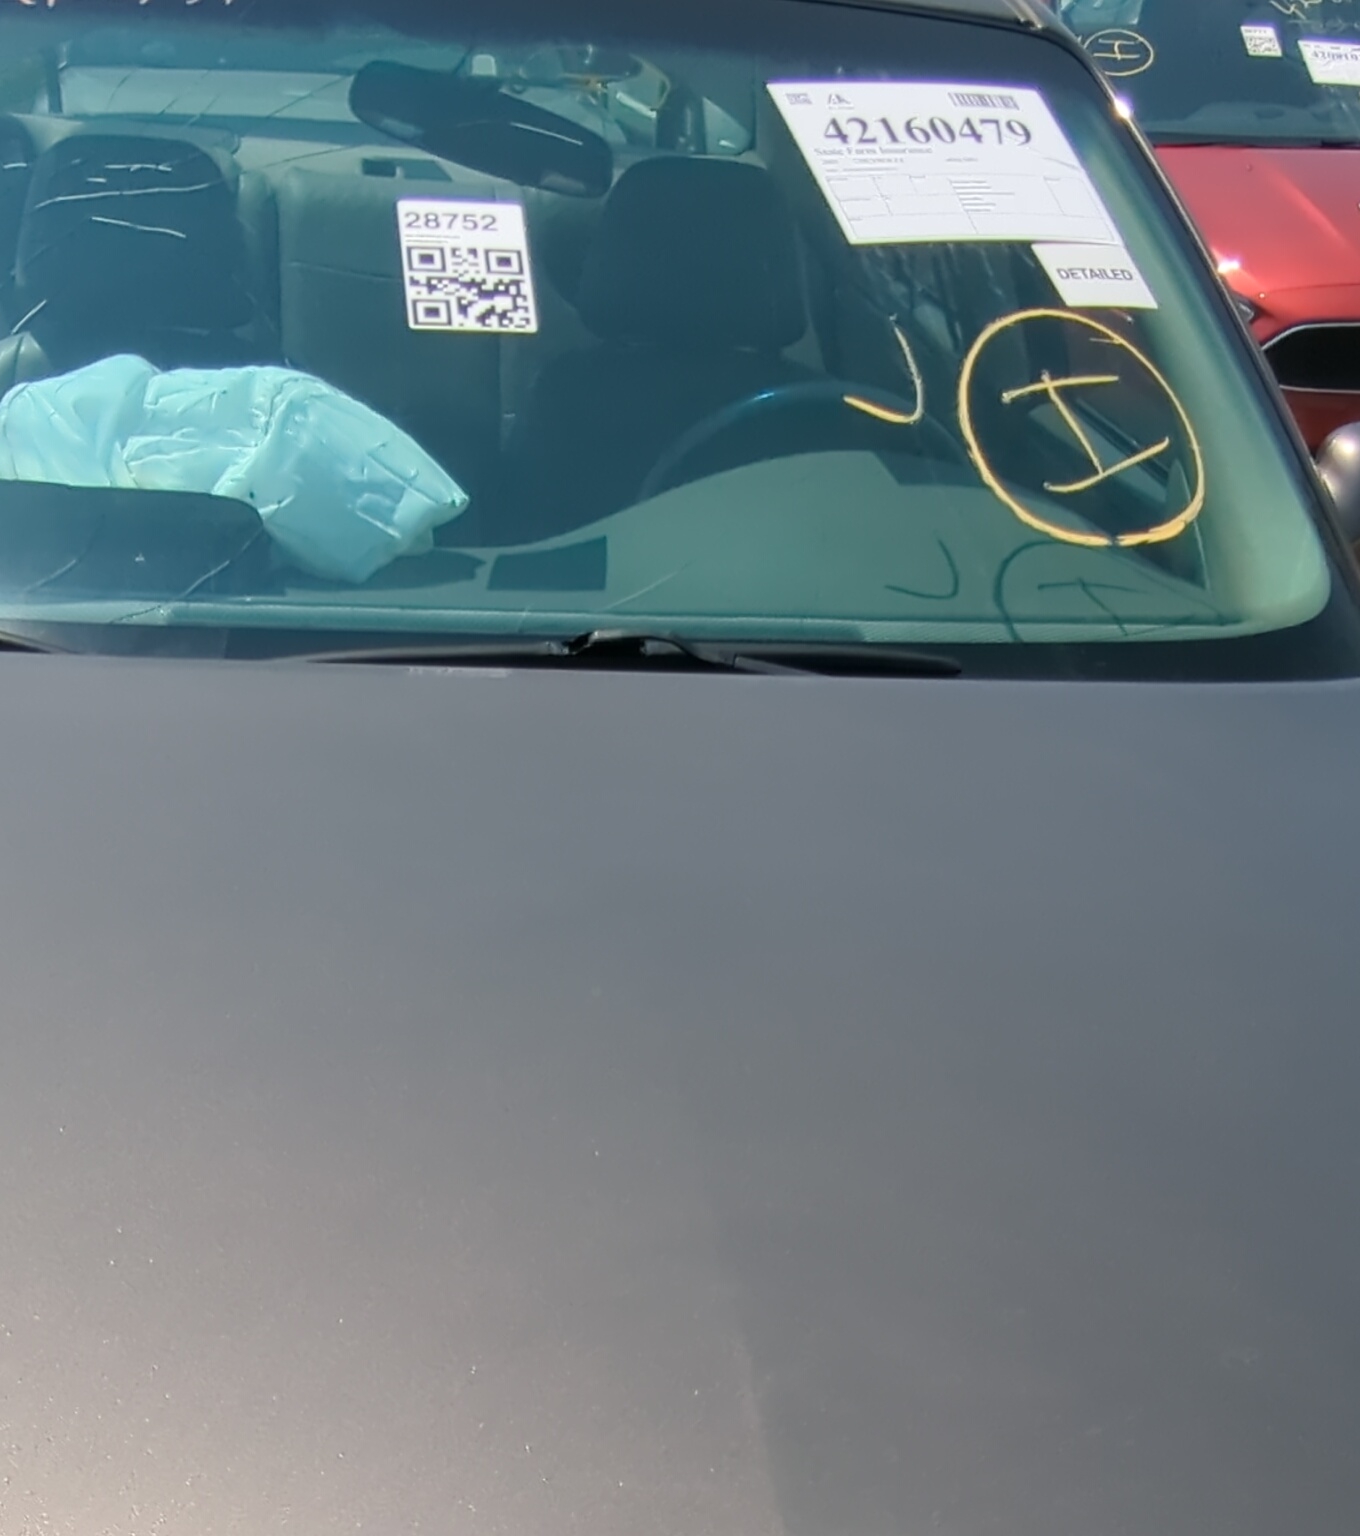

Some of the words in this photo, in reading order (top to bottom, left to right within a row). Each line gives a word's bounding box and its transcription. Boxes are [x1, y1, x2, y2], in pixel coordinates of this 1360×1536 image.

[824, 117, 1032, 146] 42160479
[403, 211, 499, 232] 28752
[1056, 267, 1133, 282] DETAILED
